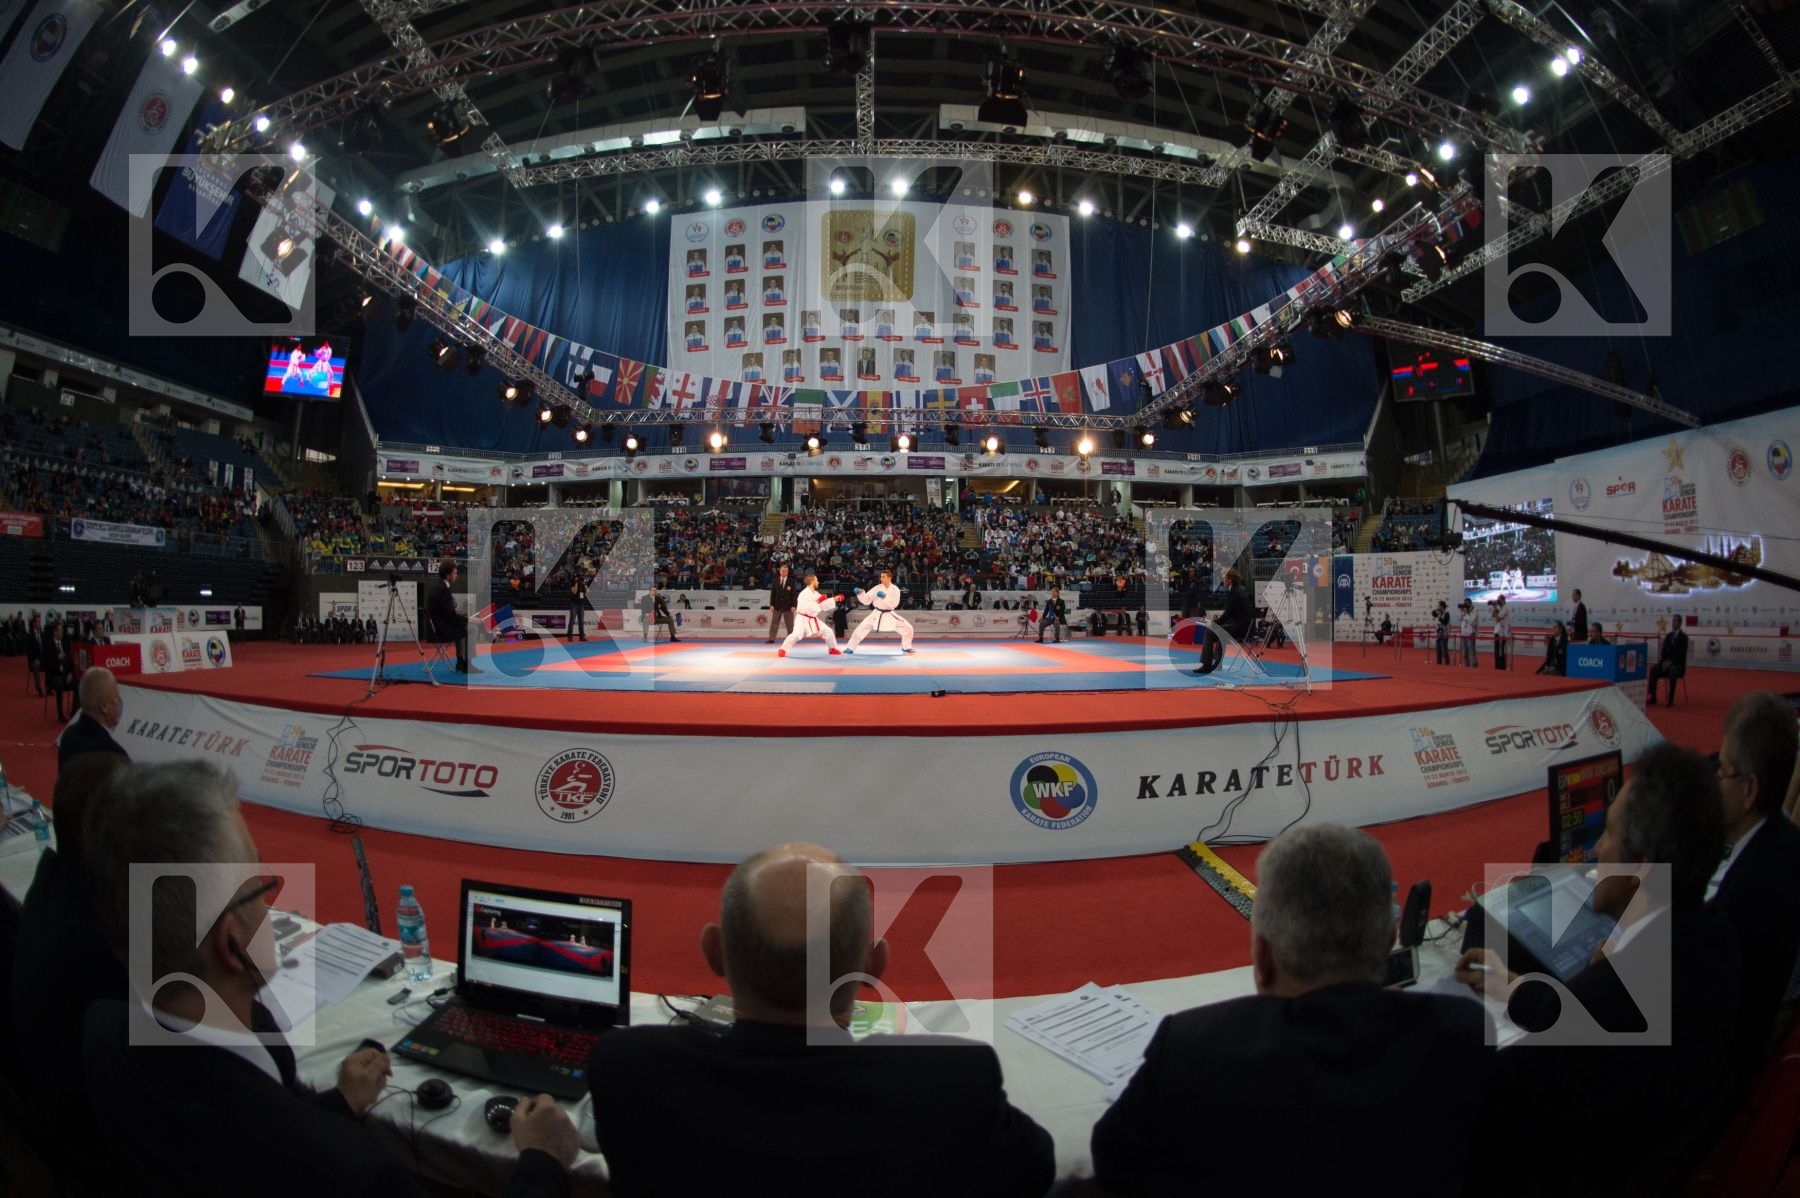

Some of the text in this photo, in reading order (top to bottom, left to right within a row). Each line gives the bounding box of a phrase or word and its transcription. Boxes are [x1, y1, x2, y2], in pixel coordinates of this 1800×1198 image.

[1662, 496, 1697, 513] KARATE
[349, 561, 364, 570] 123
[1372, 577, 1412, 588] KARATE
[106, 657, 130, 668] COACH
[182, 650, 201, 658] KARATE
[1578, 657, 1603, 668] COACH
[127, 719, 249, 757] KARATETÜRK
[1485, 724, 1577, 755] SPORTOTO
[268, 745, 314, 764] KARATE
[1029, 753, 1071, 764] EUROPEAN
[1414, 746, 1462, 765] KARATE
[344, 752, 499, 789] SPORTOTO
[1420, 760, 1465, 773] CHAMPIONSHIPS
[554, 751, 587, 767] KARATE
[588, 753, 612, 804] FEDERASYONU
[1137, 754, 1385, 800] KARATETÜRK
[1032, 781, 1074, 798] WKF
[1020, 805, 1093, 829] KARATE FEDERATION
